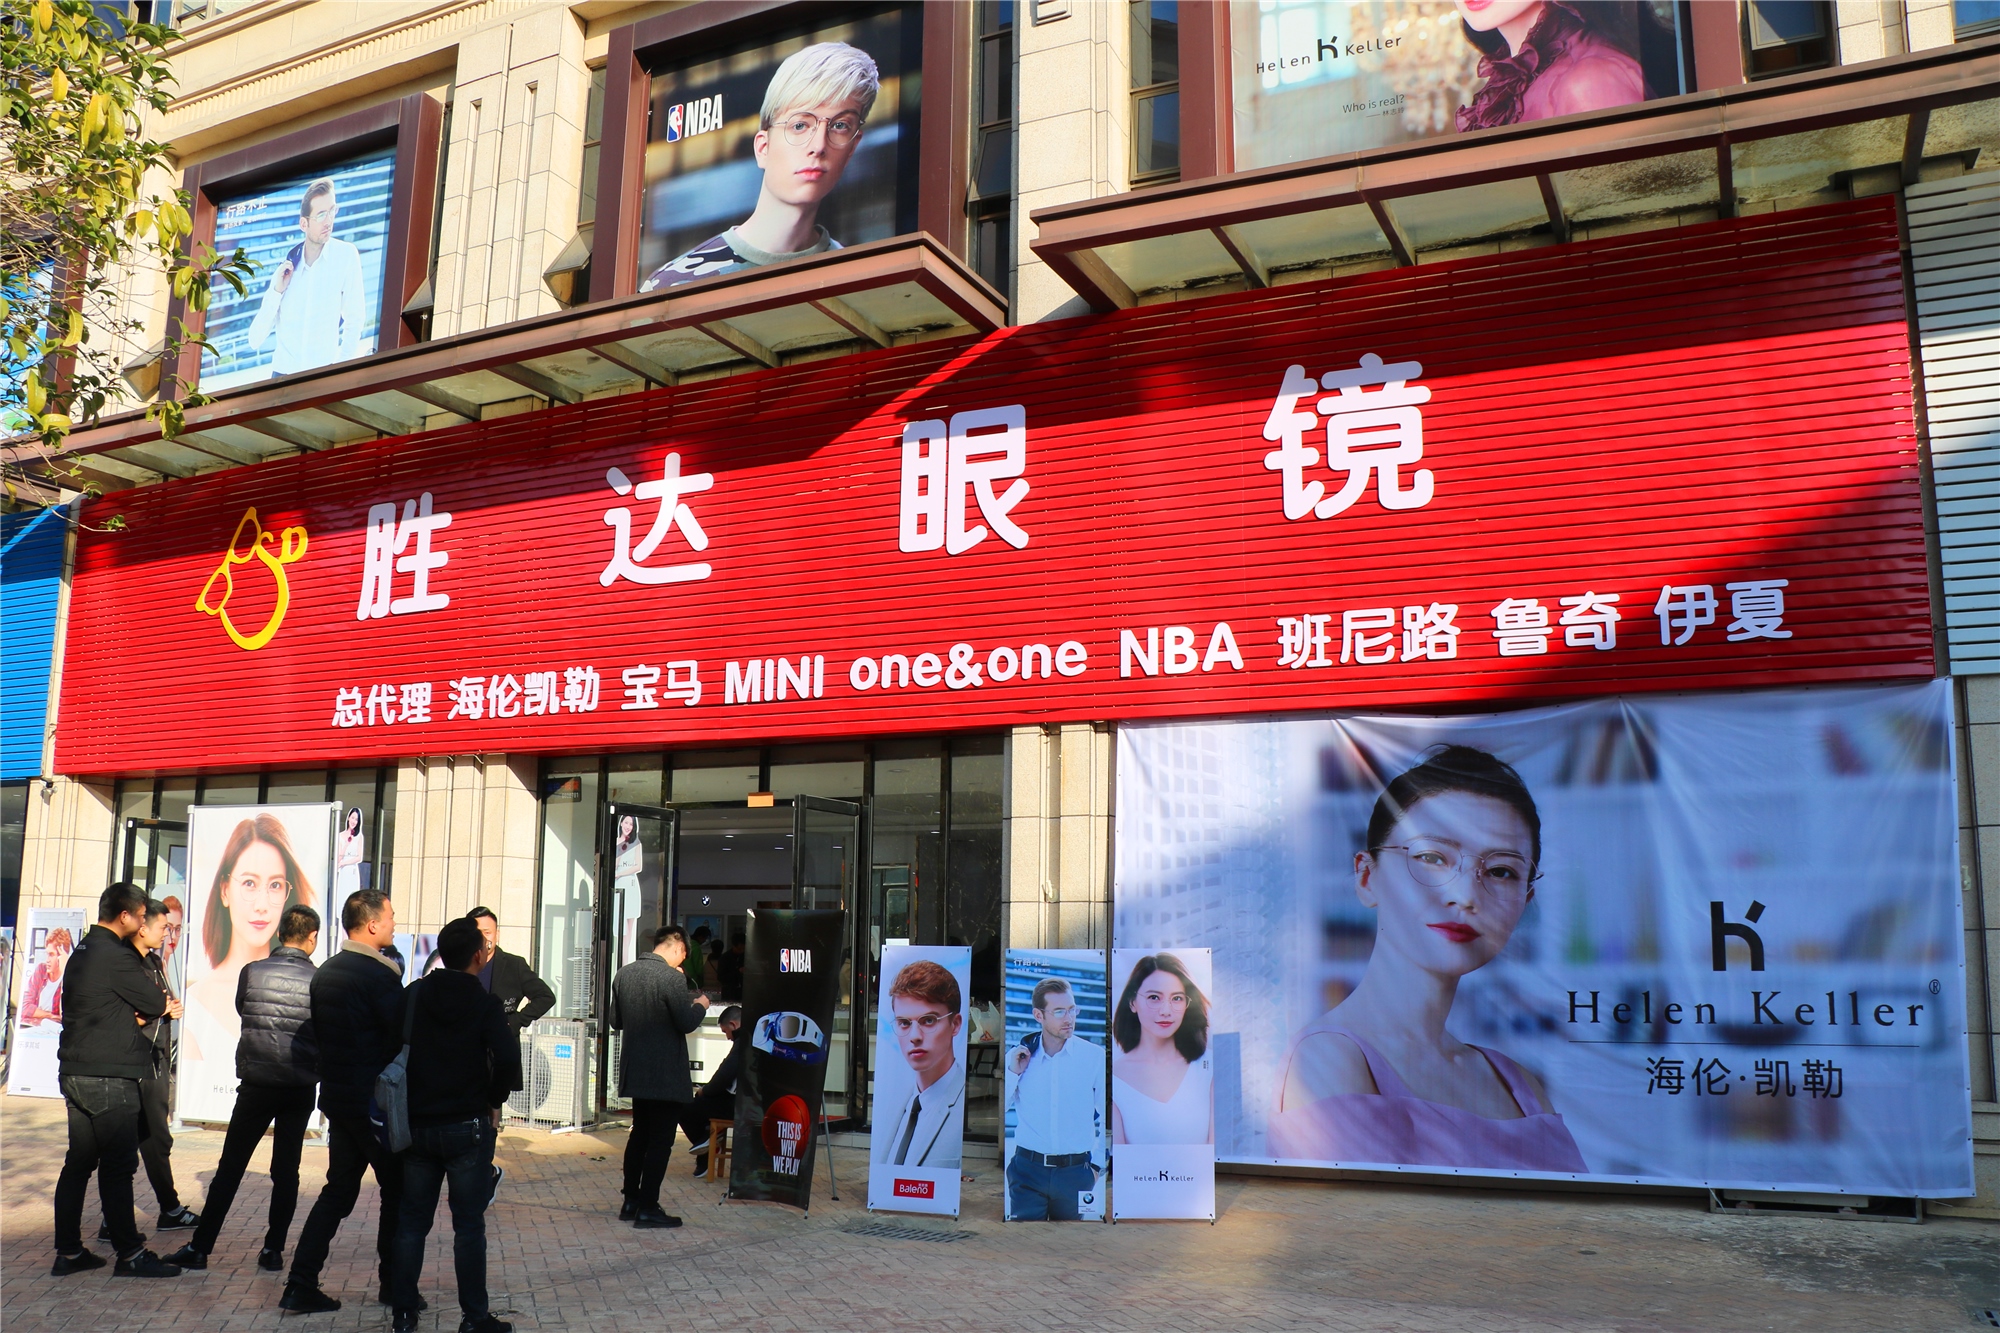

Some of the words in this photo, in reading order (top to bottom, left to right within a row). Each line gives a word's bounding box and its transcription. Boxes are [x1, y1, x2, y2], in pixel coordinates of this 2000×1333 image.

[1256, 55, 1311, 74] Helen
[1345, 37, 1402, 56] Keller
[1343, 101, 1366, 113] Who
[1368, 100, 1377, 109] is
[1379, 94, 1405, 107] real?
[684, 94, 723, 138] NBA
[331, 683, 432, 728] 总代理
[447, 666, 605, 720] 海伦凯勒
[620, 660, 706, 710] 宝马
[724, 655, 825, 704] MINI
[849, 640, 1089, 690] one&one
[1120, 622, 1245, 678] NBA
[1276, 602, 1462, 669] 班尼路
[1490, 591, 1622, 657] 鲁奇
[1653, 579, 1793, 646] 伊夏
[790, 949, 812, 973] NBA
[1013, 957, 1051, 967] 行路不止
[1567, 990, 1718, 1024] Helen
[1752, 990, 1924, 1026] Keller
[1645, 1056, 1843, 1099] 海伦·凯勒
[213, 1084, 237, 1095] Hele
[777, 1121, 795, 1139] THIS
[781, 1139, 797, 1157] WHY
[773, 1155, 785, 1174] WE
[785, 1156, 801, 1176] PLAY
[899, 1184, 929, 1195] Baleno
